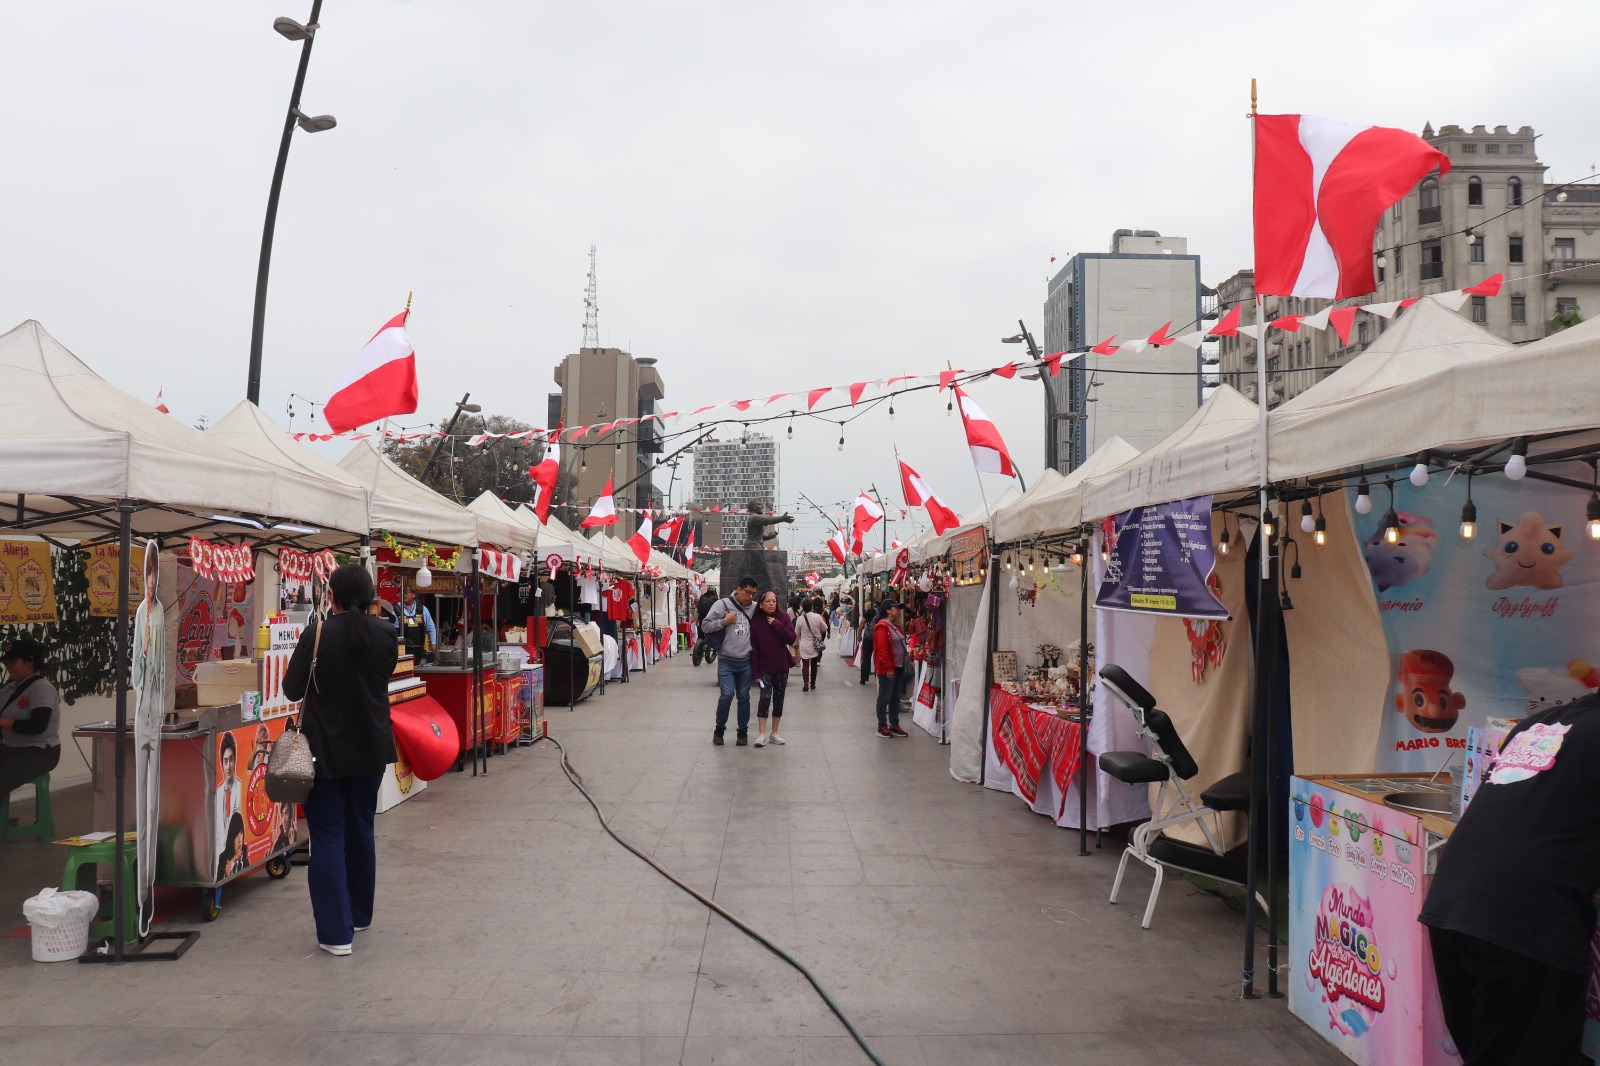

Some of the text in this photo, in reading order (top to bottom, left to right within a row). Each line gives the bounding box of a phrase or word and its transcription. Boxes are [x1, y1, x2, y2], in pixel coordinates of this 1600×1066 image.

[4, 543, 29, 558] Abeja
[95, 546, 121, 558] La Abe
[1492, 597, 1558, 617] Jigglypuff
[1, 614, 19, 622] POLEN
[278, 627, 295, 641] MENÚ
[1396, 737, 1467, 751] MARIO BRO
[1329, 887, 1366, 928] Mundo
[1316, 915, 1381, 976] MAGICO
[1309, 944, 1383, 1004] Algodones
